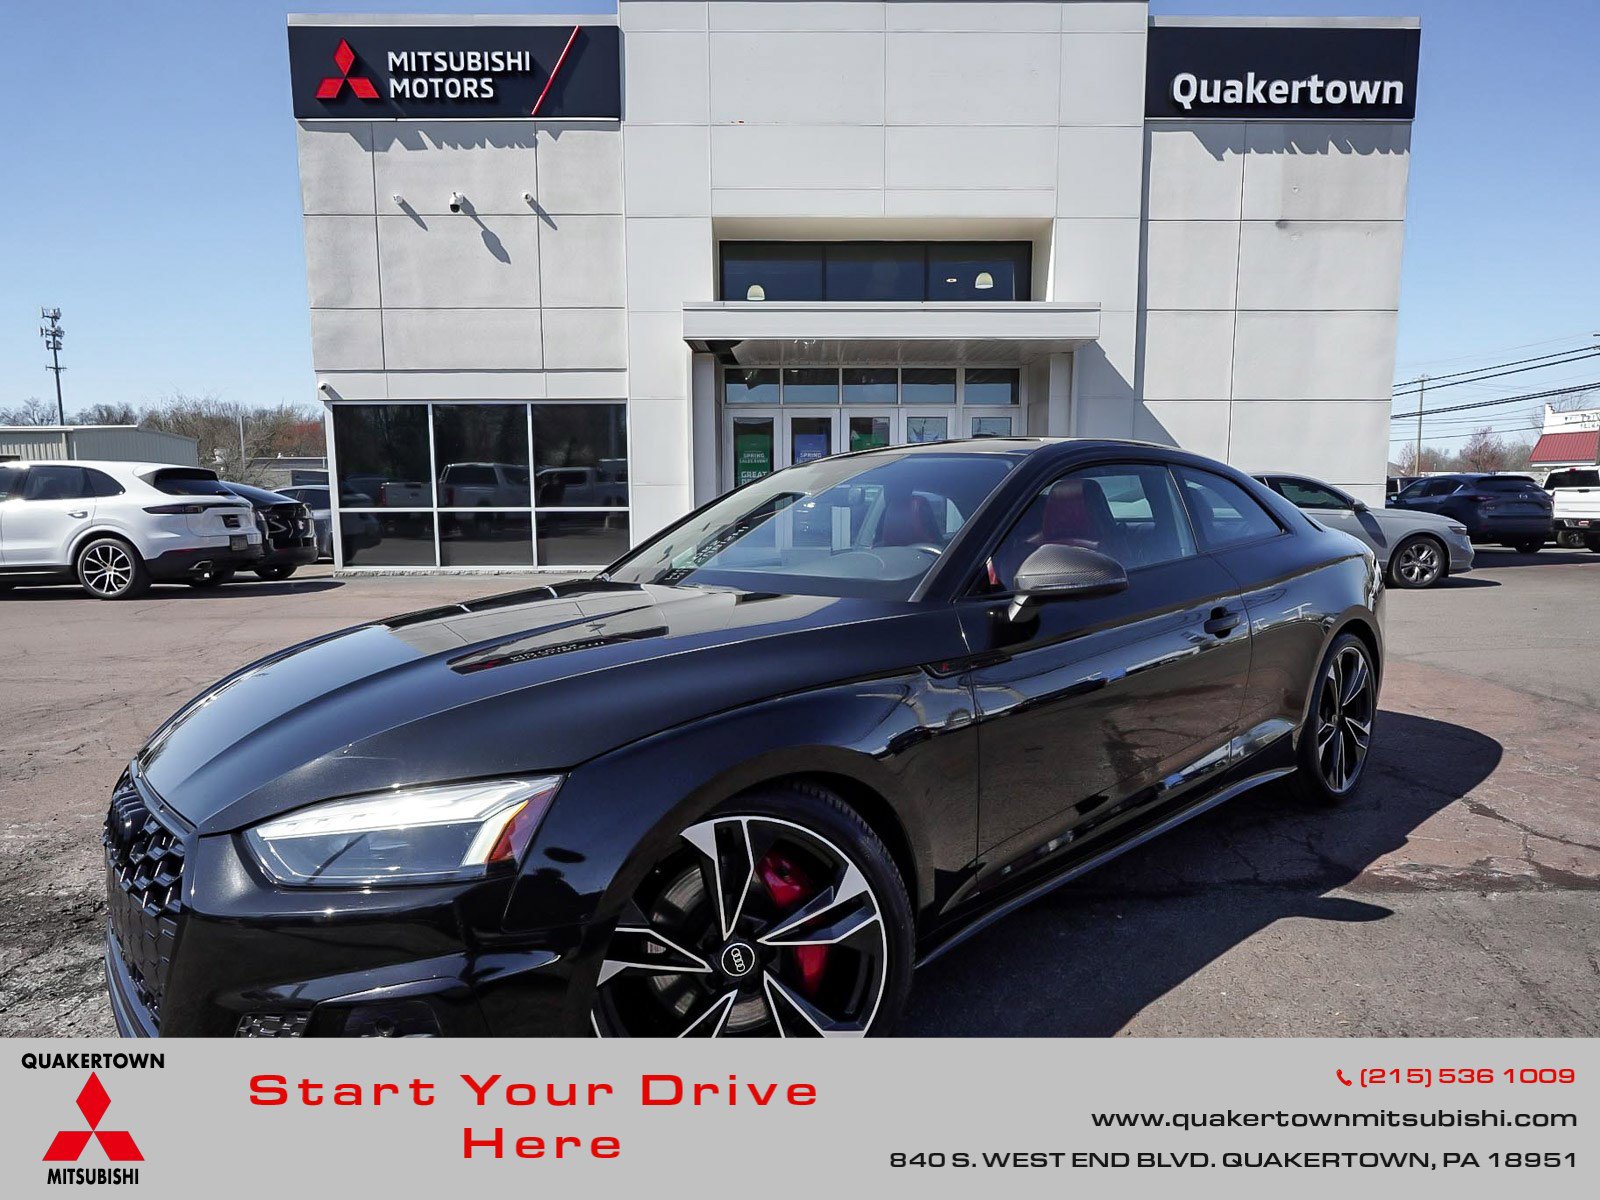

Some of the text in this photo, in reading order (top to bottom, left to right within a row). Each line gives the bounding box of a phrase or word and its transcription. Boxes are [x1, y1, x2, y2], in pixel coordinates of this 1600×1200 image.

[387, 50, 531, 72] MITSUBISHI
[388, 77, 494, 99] MOTORS
[1172, 72, 1404, 110] Quakertown
